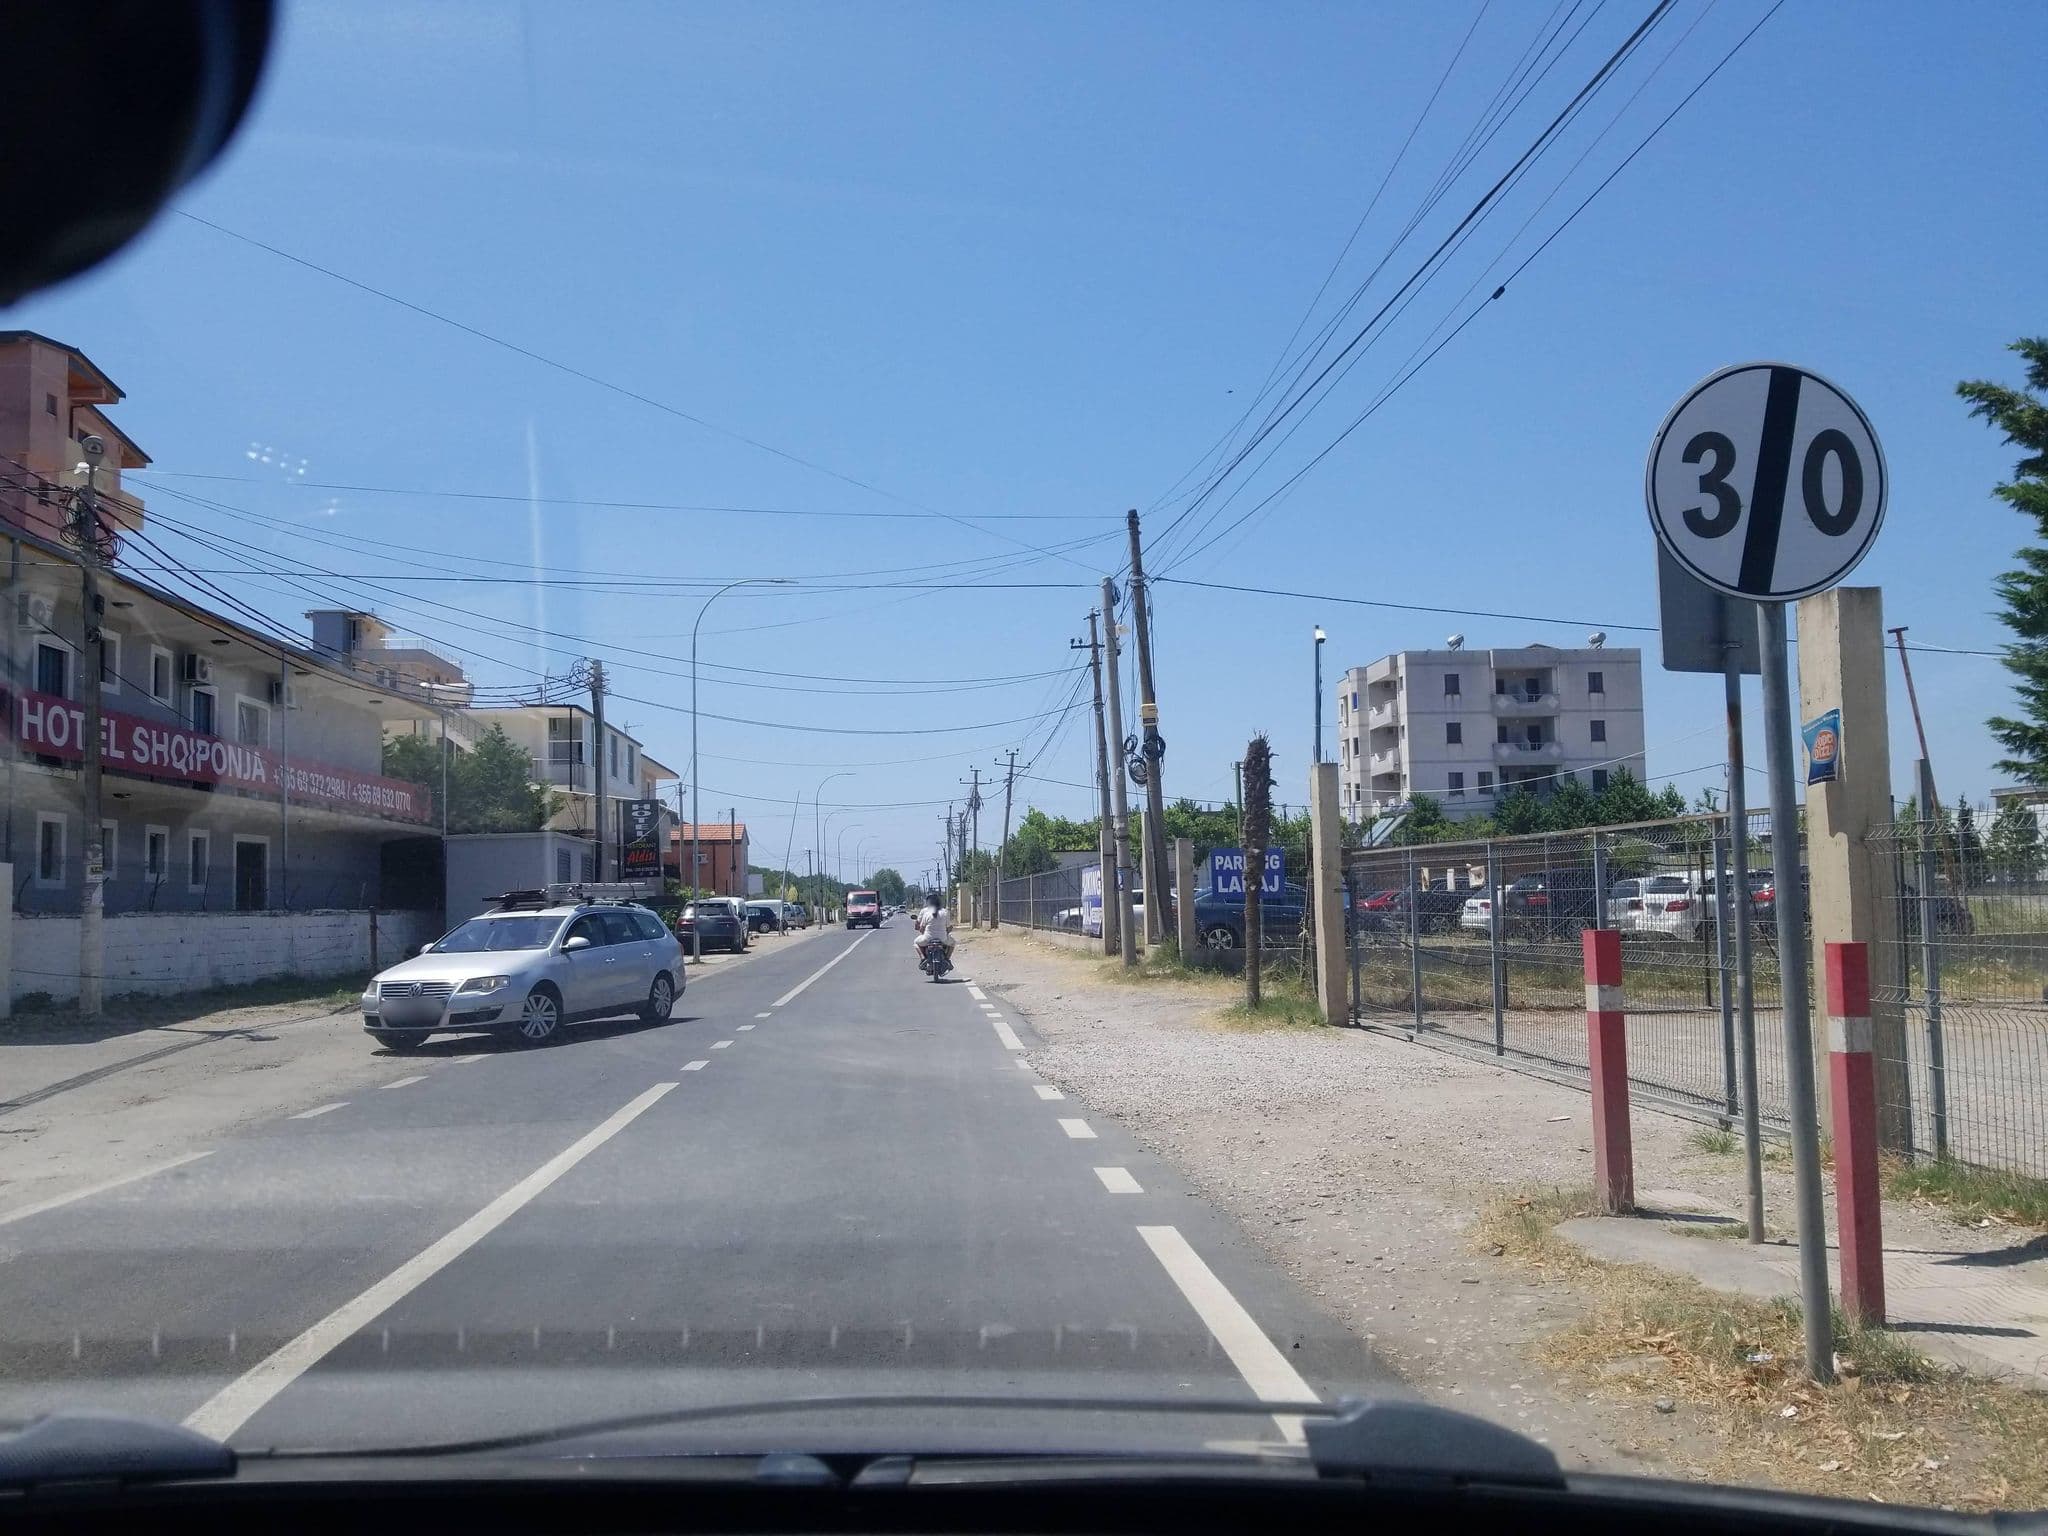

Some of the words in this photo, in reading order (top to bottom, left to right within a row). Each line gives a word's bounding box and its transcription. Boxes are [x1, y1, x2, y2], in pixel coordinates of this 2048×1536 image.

[1681, 428, 1864, 539] 30
[22, 698, 125, 759] HOTEL
[132, 726, 266, 783] SHQIPONJA
[1215, 855, 1280, 870] PARG
